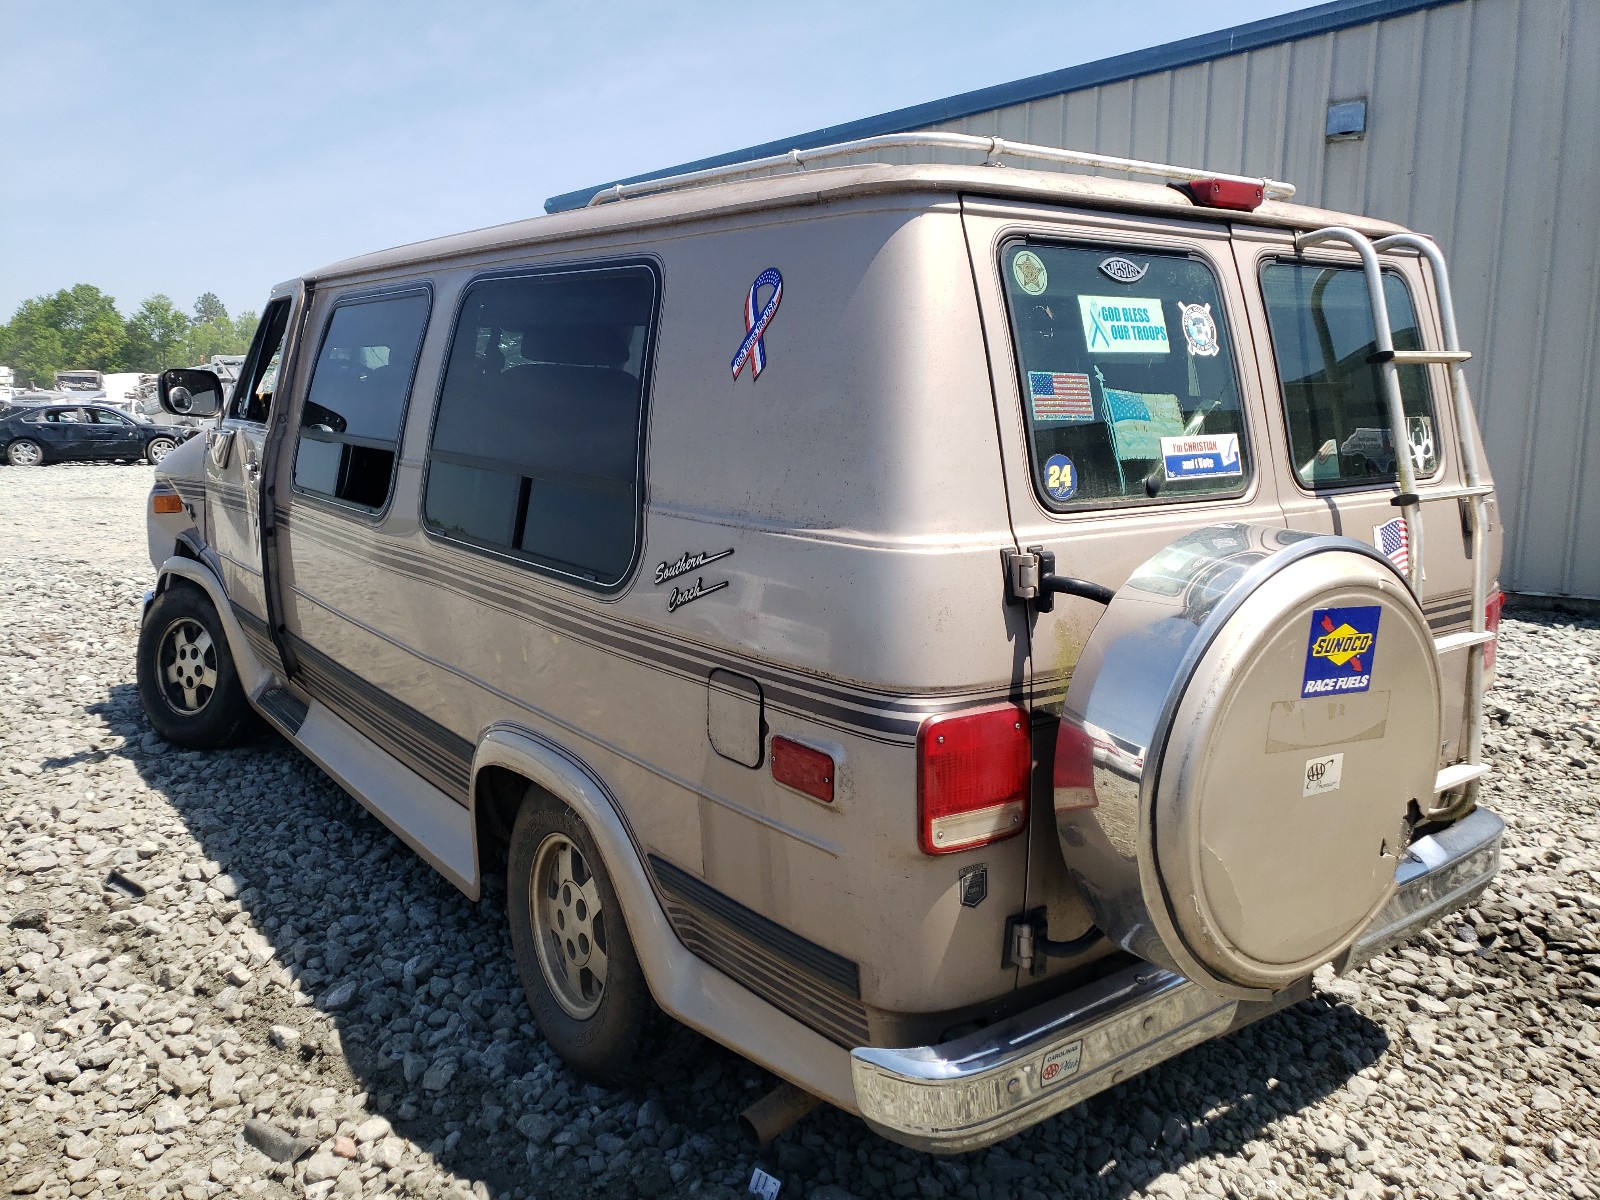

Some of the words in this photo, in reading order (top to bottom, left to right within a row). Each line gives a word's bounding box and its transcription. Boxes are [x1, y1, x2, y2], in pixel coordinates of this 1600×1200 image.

[763, 300, 777, 318] USA
[1101, 306, 1122, 322] GOD
[1122, 307, 1150, 323] BLESS
[1110, 324, 1131, 341] OUR
[1131, 325, 1167, 341] TROOPS
[1183, 440, 1218, 453] CHRISTIAN
[1182, 459, 1195, 470] and
[1198, 457, 1215, 469] Vote
[1048, 464, 1072, 488] 24
[654, 549, 733, 585] Southern
[667, 577, 728, 613] Coach
[1315, 635, 1370, 655] SUNOCO
[1303, 678, 1337, 693] RACE
[1335, 674, 1370, 690] FUELS
[1047, 1045, 1079, 1062] CAROLINAS
